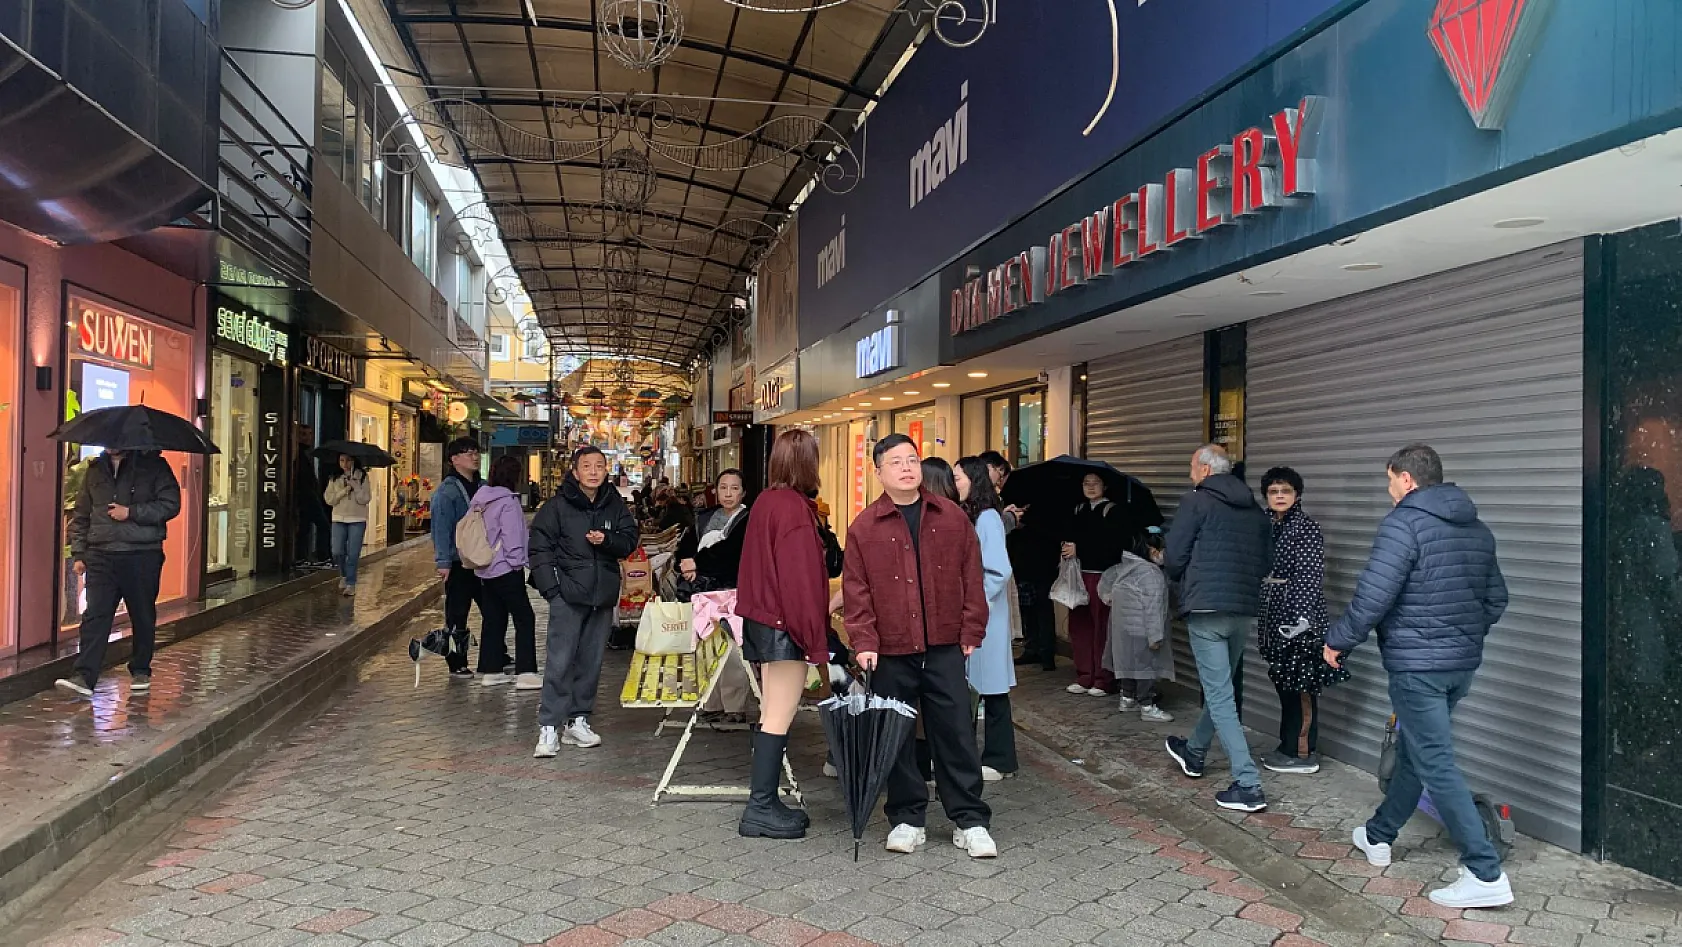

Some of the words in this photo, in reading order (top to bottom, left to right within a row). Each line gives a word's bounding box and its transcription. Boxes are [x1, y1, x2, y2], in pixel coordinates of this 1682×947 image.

[910, 79, 969, 209] mavi
[1045, 95, 1314, 296] JEWELLERY
[817, 213, 846, 289] mavi
[81, 308, 153, 367] SUWEN
[855, 309, 899, 379] mavi
[263, 412, 279, 493] SILVER
[263, 508, 276, 548] 925
